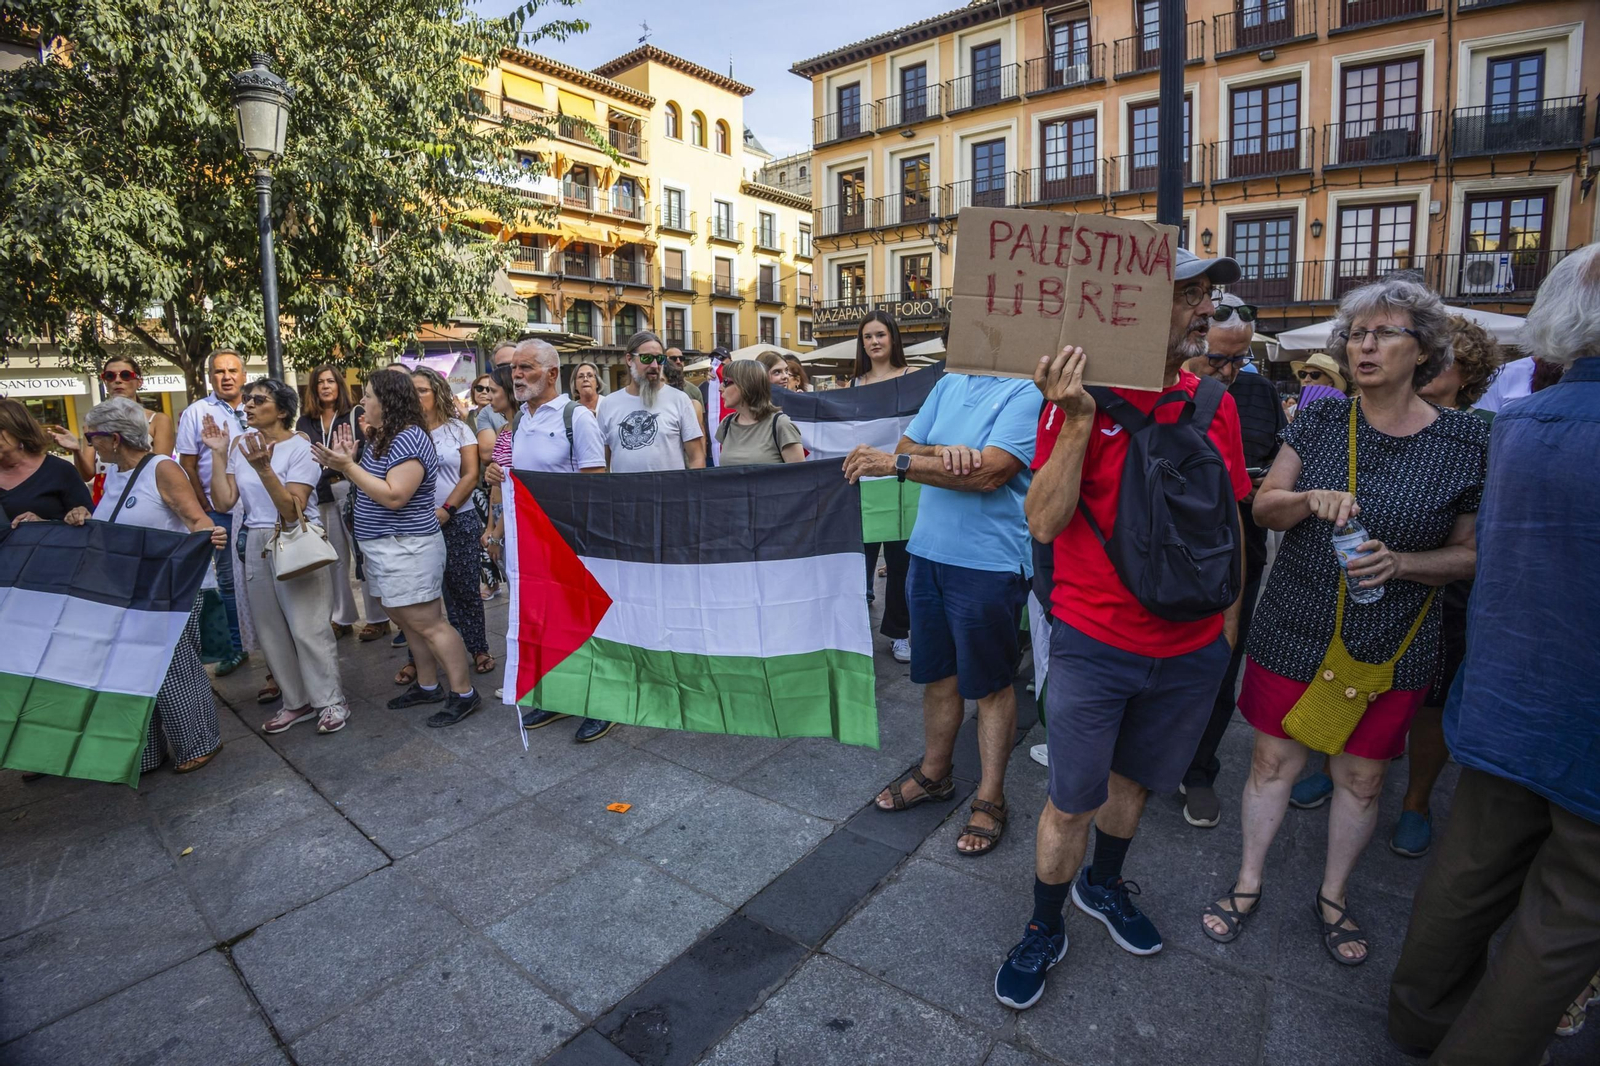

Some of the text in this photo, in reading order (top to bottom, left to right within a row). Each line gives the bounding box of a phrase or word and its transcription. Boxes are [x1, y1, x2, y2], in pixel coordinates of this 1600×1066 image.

[989, 220, 1172, 282] PALESTINA
[814, 305, 868, 323] MAZAPAN
[895, 301, 933, 316] FORO
[0, 379, 42, 389] SANTO
